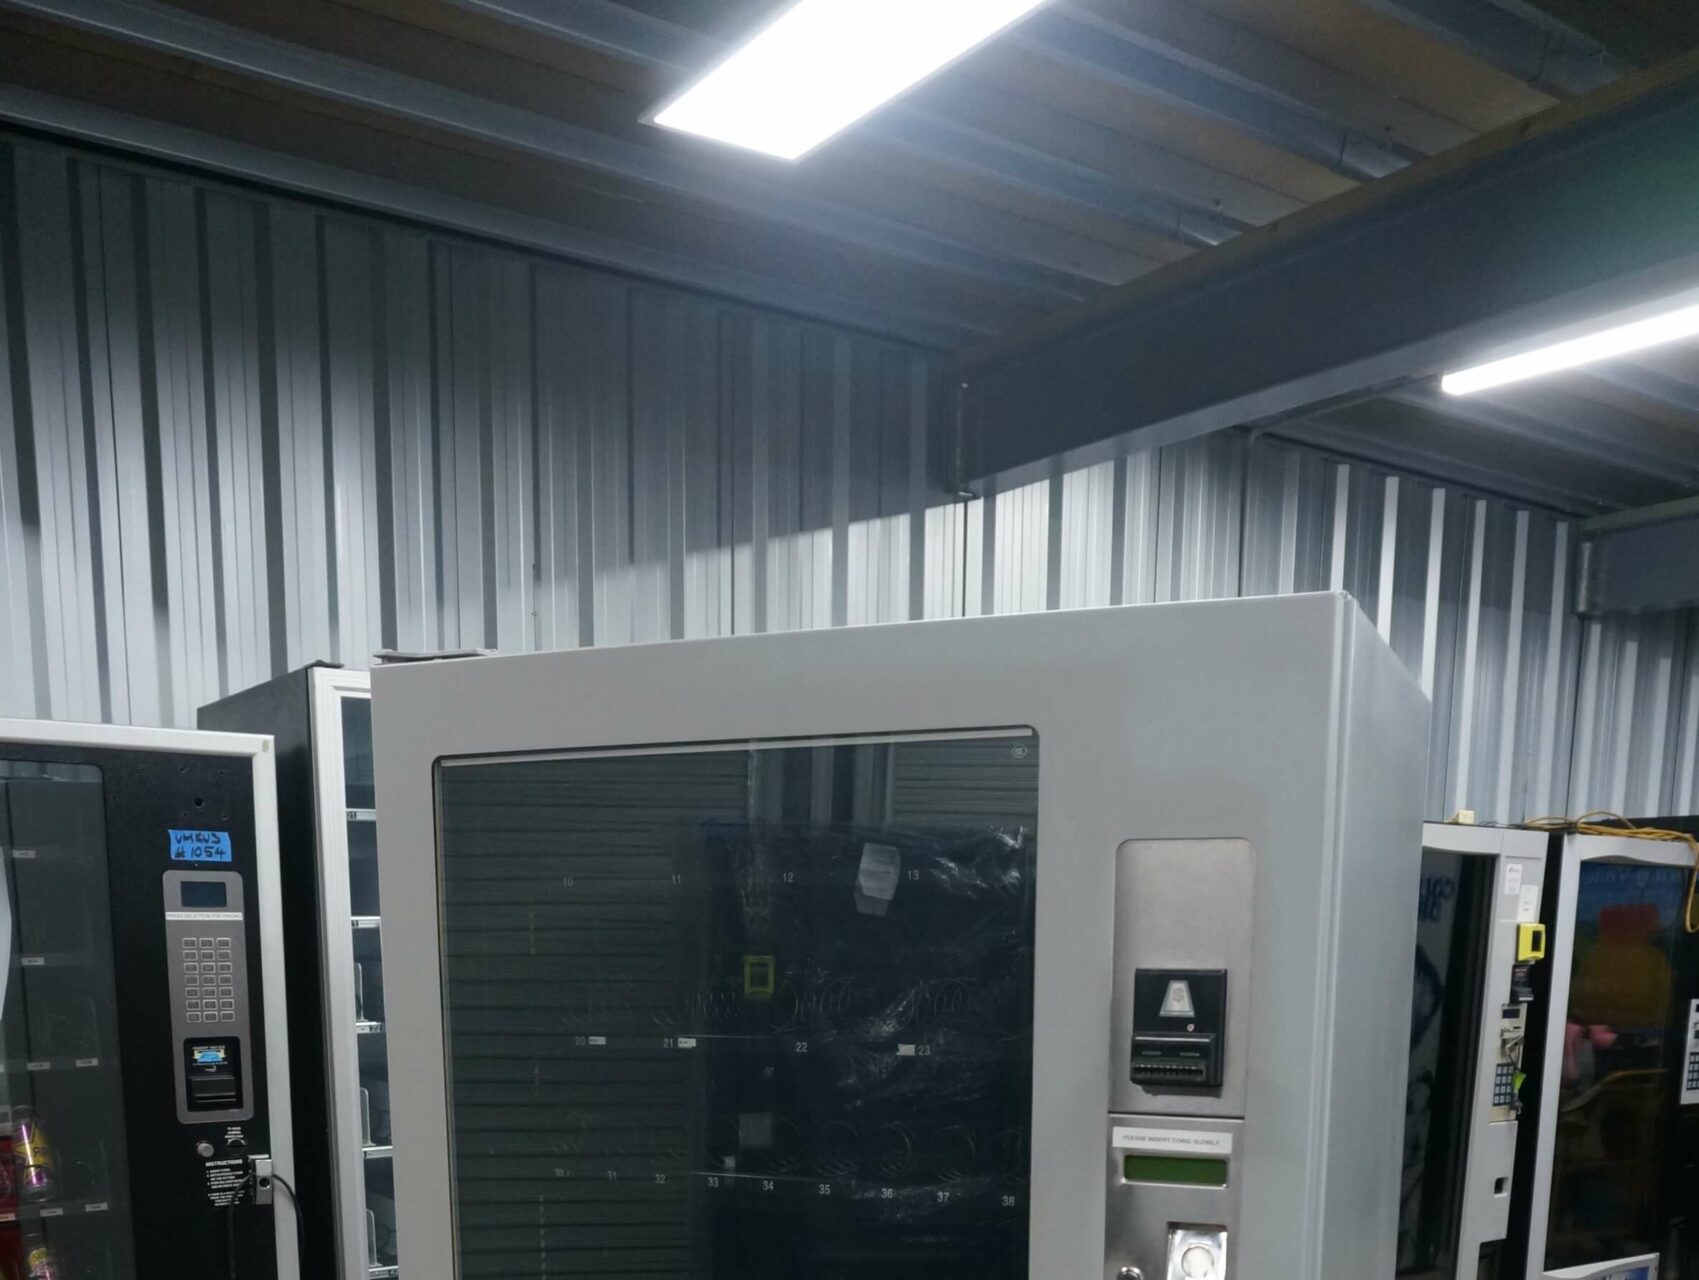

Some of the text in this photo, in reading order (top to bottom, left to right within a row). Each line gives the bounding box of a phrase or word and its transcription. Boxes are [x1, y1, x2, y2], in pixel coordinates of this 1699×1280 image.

[191, 846, 226, 860] 1054
[673, 874, 681, 885] 11
[783, 871, 794, 883] 12
[907, 869, 919, 880] 13
[563, 876, 574, 887] 10
[663, 1038, 674, 1049] 21
[795, 1041, 808, 1053] 22
[918, 1044, 930, 1056] 23
[655, 1173, 666, 1184] 32
[707, 1176, 719, 1188] 33
[762, 1179, 774, 1191] 34
[818, 1183, 831, 1195] 35
[881, 1188, 893, 1199] 36
[937, 1191, 950, 1203] 37
[1001, 1195, 1015, 1207] 38
